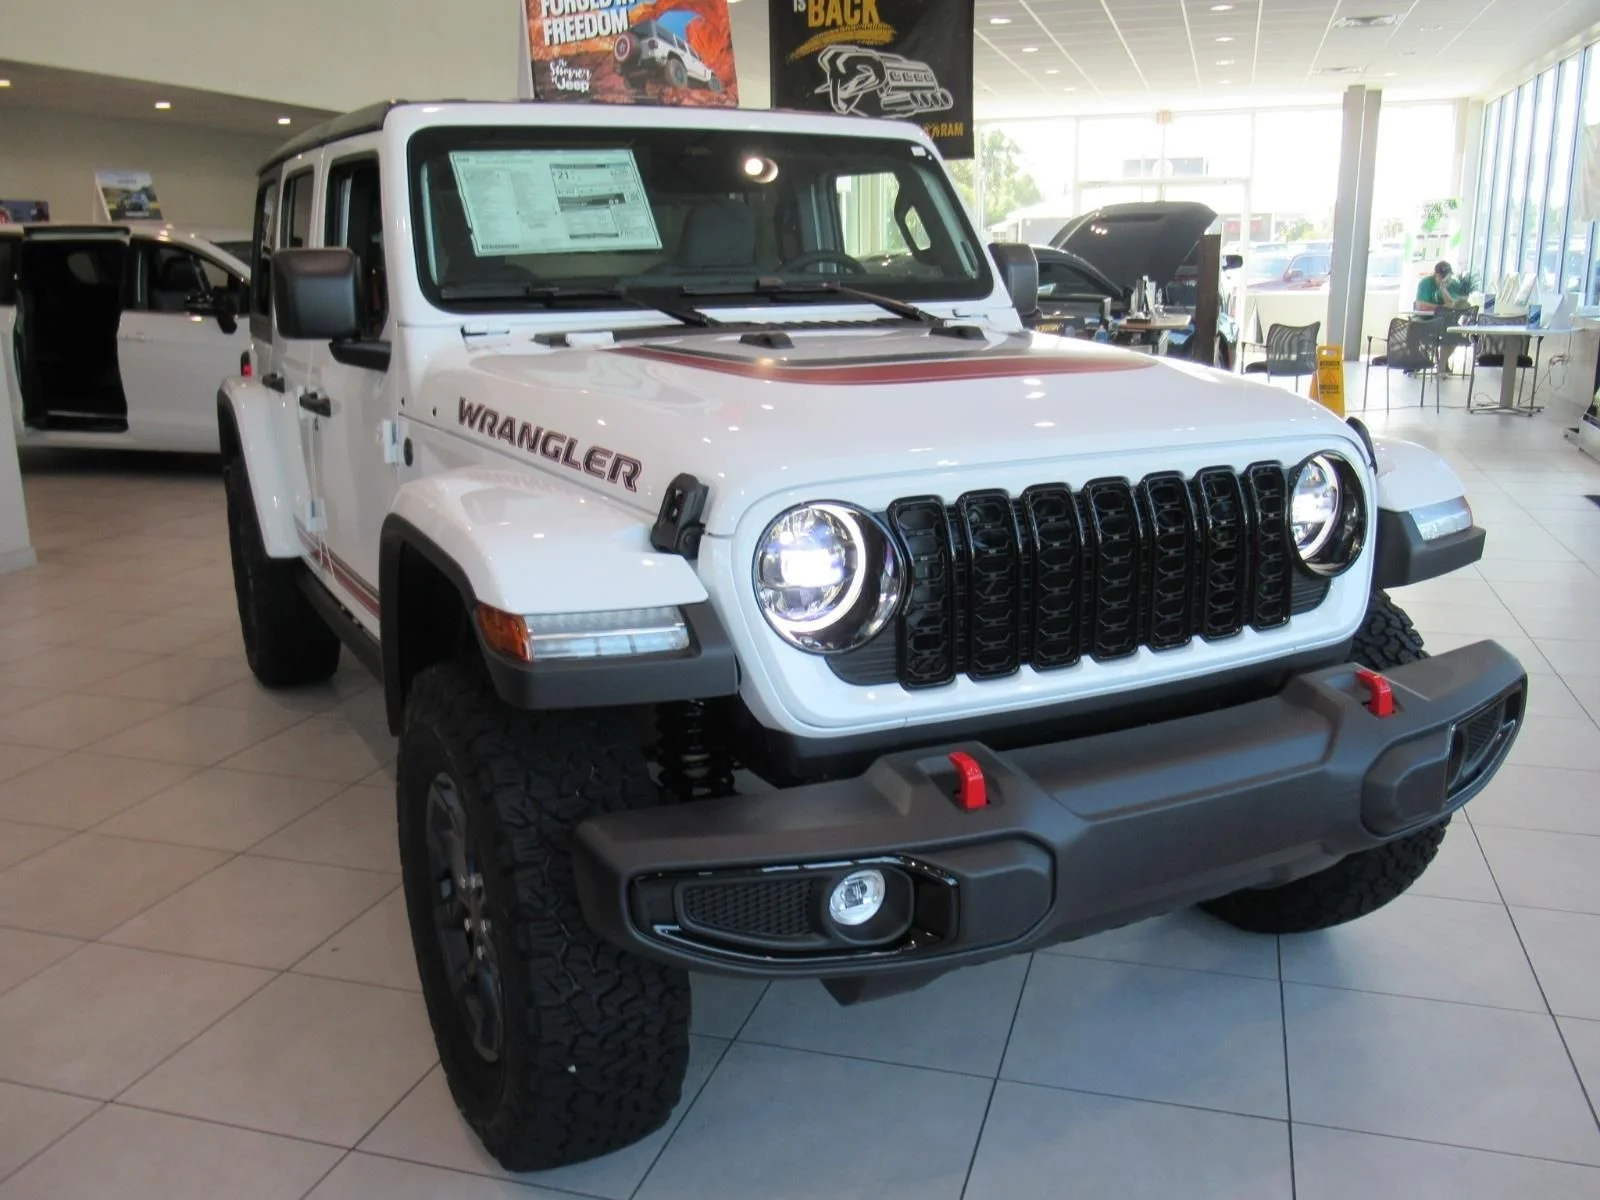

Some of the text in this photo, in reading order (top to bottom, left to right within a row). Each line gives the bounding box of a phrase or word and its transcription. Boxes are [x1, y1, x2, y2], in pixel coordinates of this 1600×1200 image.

[808, 0, 881, 27] BACK
[543, 9, 629, 46] FREEDOM
[557, 77, 589, 92] Jeep
[940, 122, 964, 137] RAM
[458, 396, 643, 493] WRANGLER
